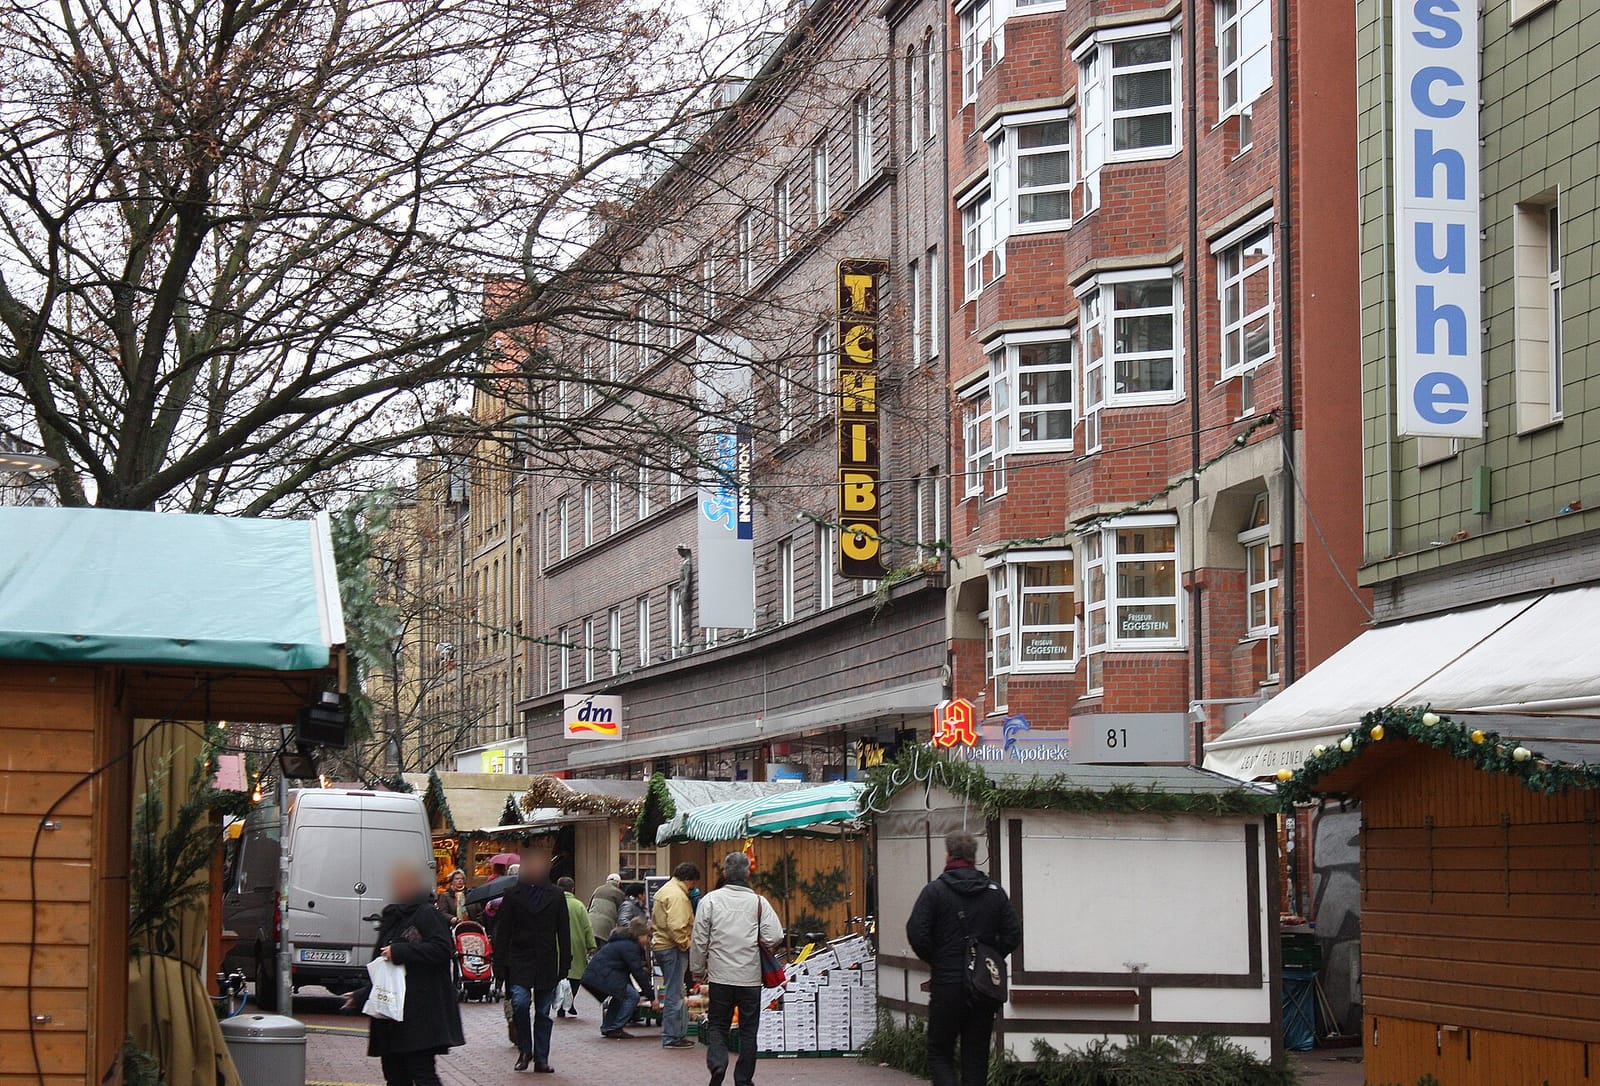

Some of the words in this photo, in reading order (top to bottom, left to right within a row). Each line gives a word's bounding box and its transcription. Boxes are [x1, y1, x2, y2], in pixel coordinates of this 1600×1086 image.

[1410, 0, 1469, 425] schuhe
[842, 274, 880, 561] TCHIBO
[1122, 620, 1169, 631] EGGESTEIN
[1128, 613, 1153, 621] FRISEUR
[1026, 645, 1067, 655] EGGESTEIN
[577, 701, 612, 722] dm
[1107, 728, 1127, 748] 81
[1009, 743, 1069, 764] Apotheke
